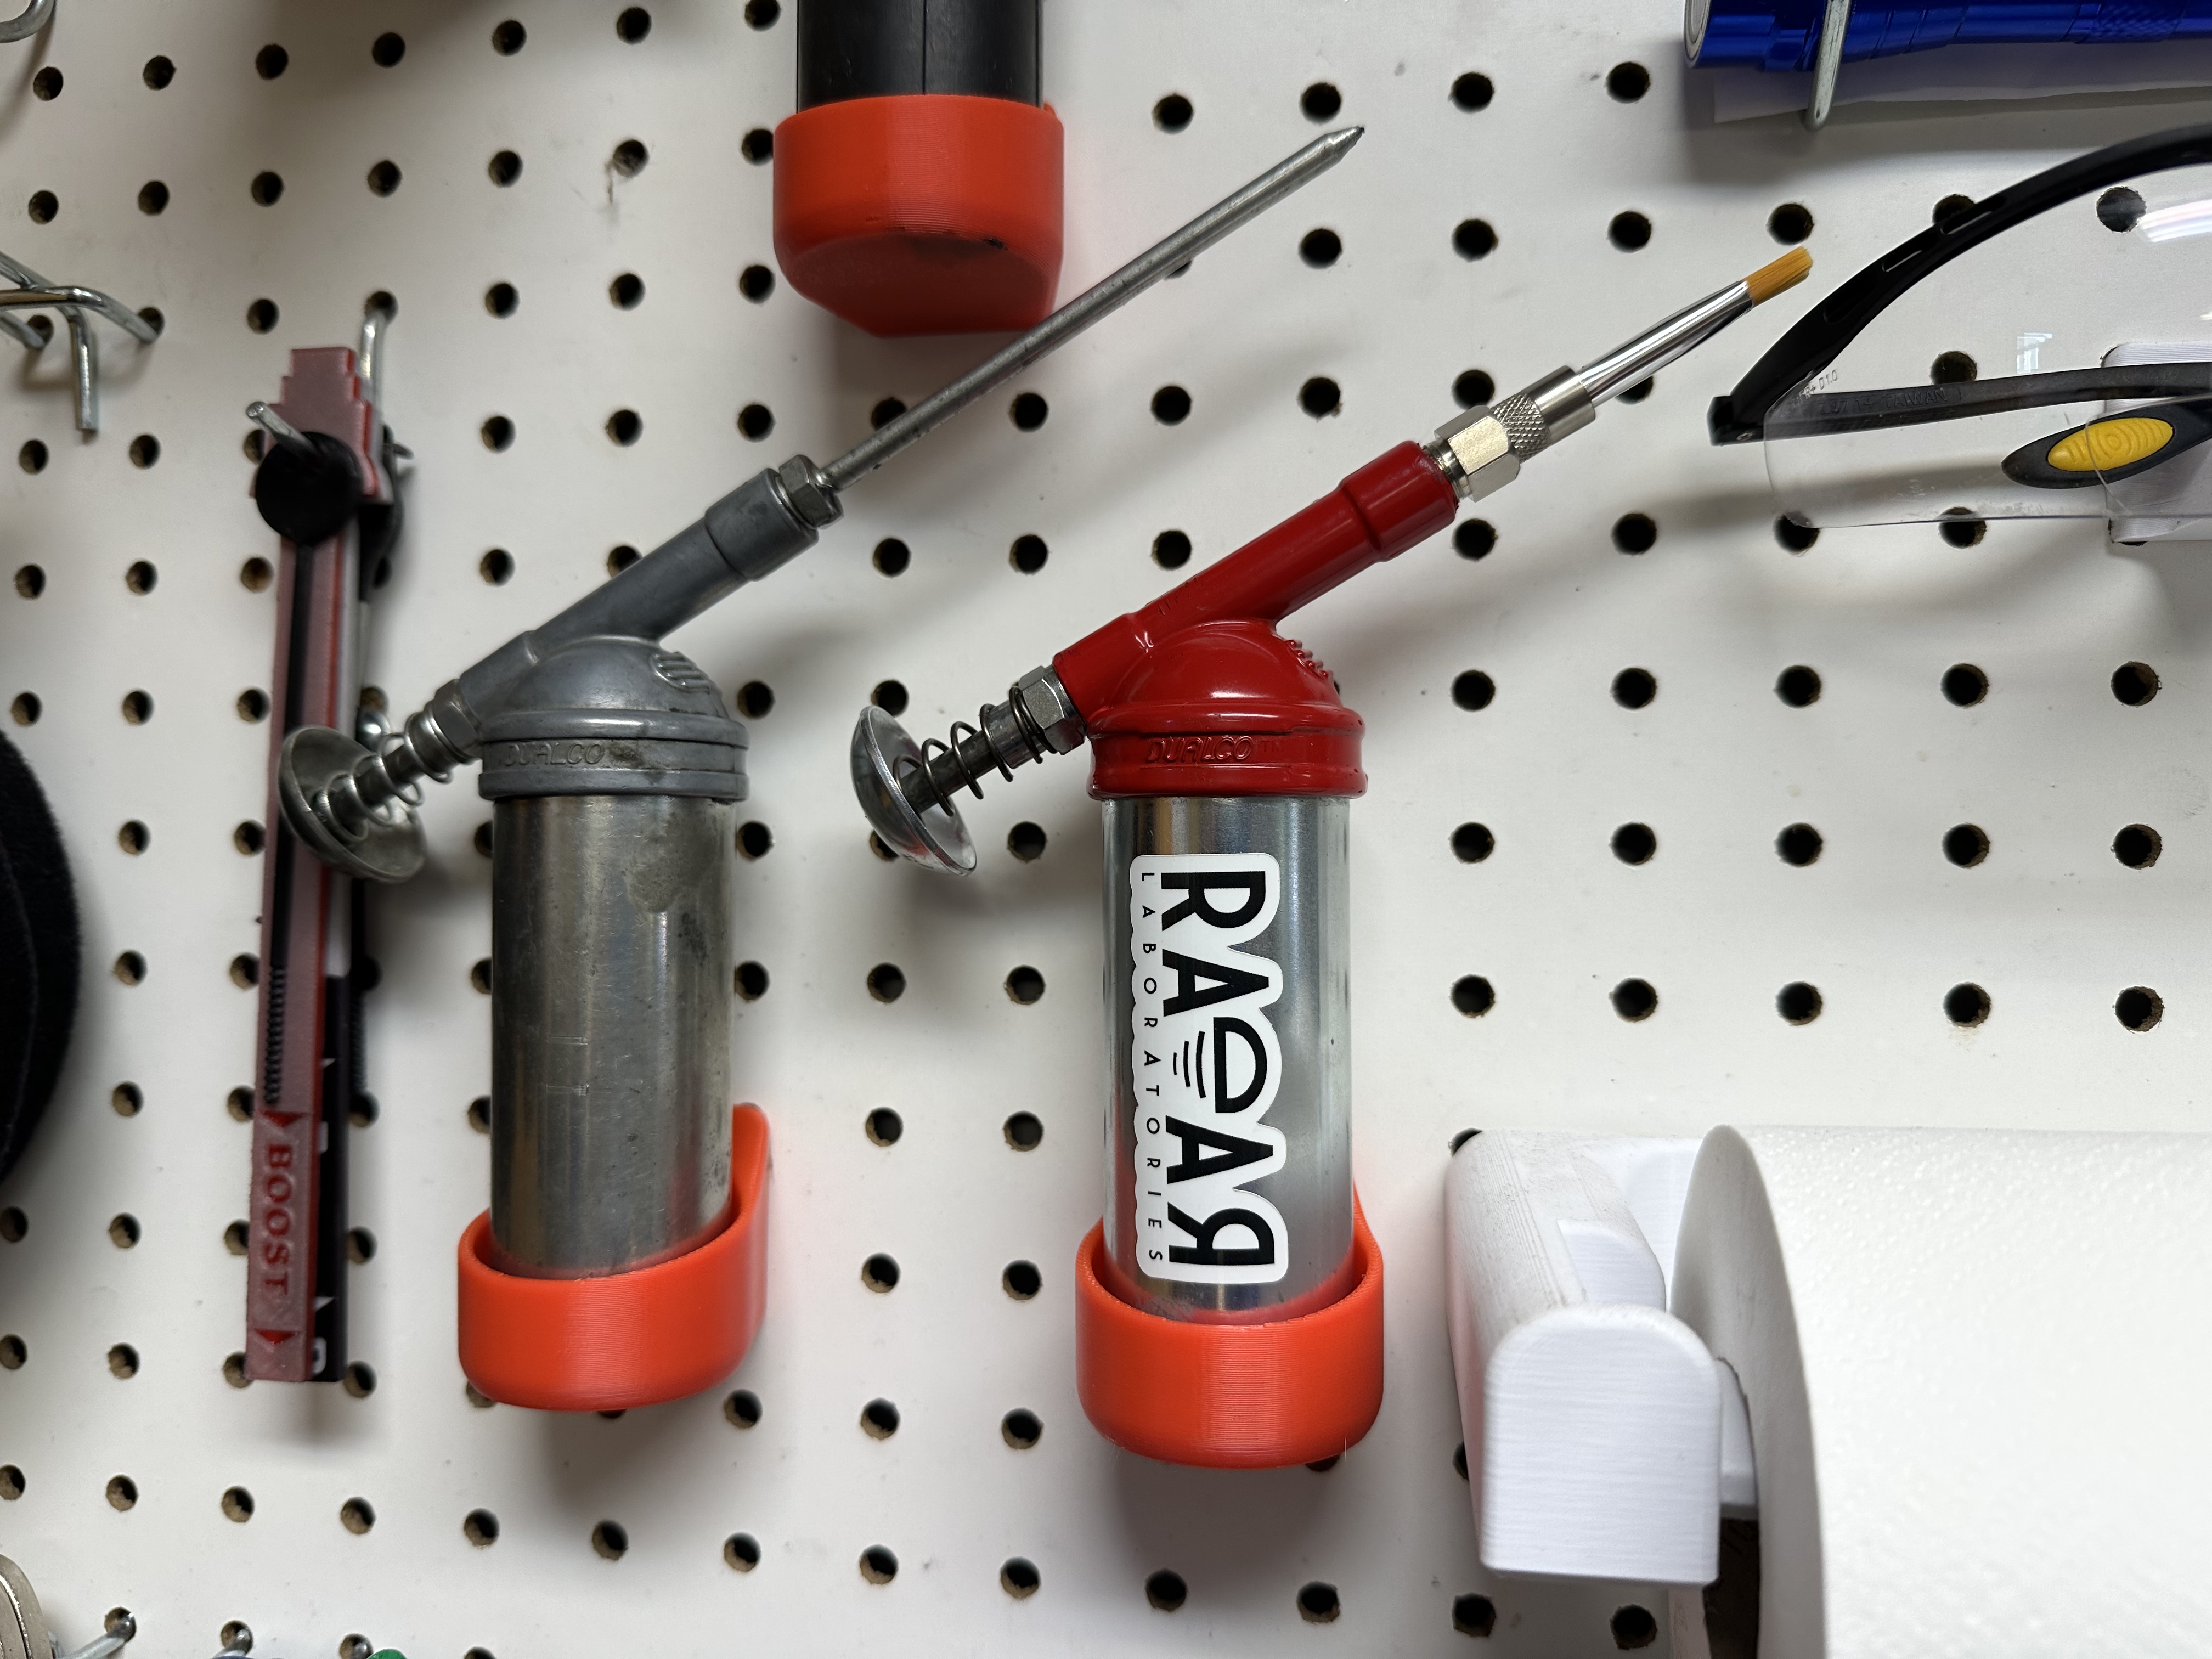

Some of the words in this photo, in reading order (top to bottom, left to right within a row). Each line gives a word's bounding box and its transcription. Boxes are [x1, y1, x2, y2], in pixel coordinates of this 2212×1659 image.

[1884, 388, 1948, 408] TAIWAN
[504, 741, 605, 767] DUALCO
[1145, 735, 1255, 762] DUALCO
[1142, 872, 1163, 1261] LABORATORIES
[264, 1145, 293, 1296] BOOST
